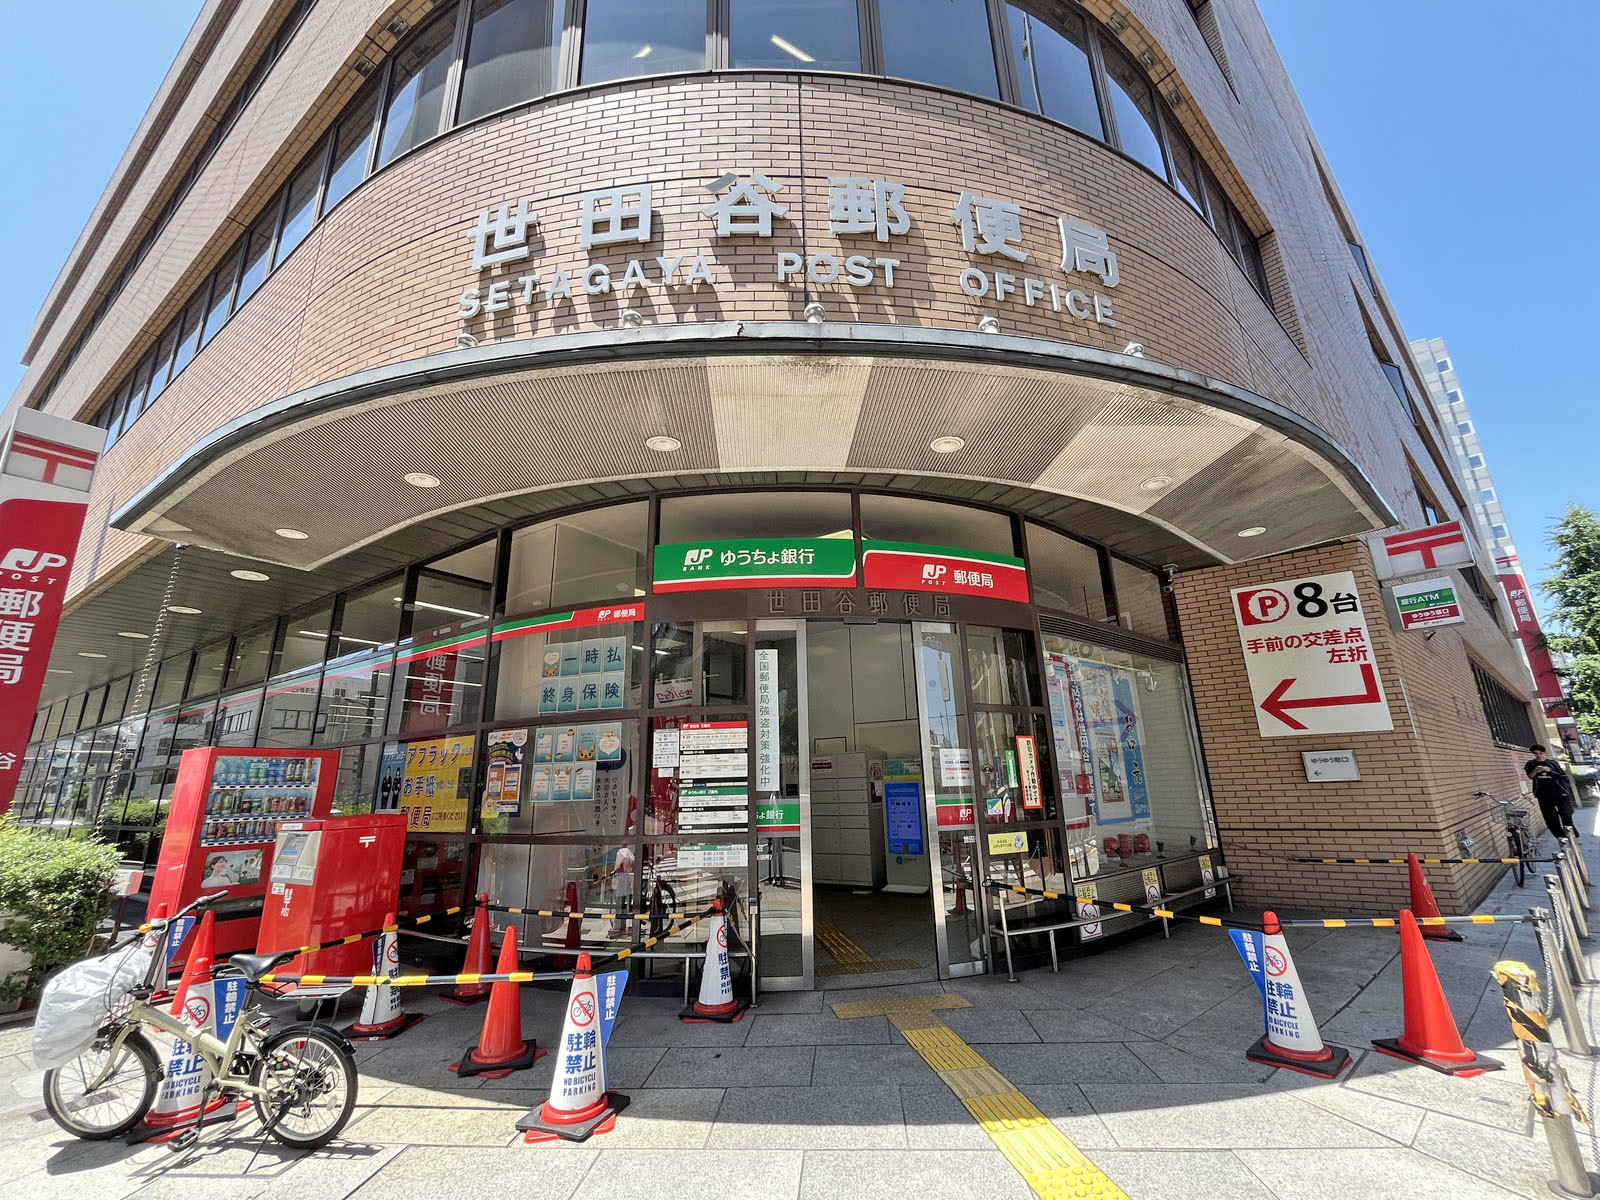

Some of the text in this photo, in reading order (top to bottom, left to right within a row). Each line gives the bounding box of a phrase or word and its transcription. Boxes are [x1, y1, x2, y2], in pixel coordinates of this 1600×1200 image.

[466, 171, 1121, 288] 世田谷郵便局
[458, 251, 1116, 327] SETAGAYA POST OFFICE
[720, 548, 816, 567] ゆうちょ銀行
[0, 570, 56, 585] OST
[953, 569, 995, 588] 郵便局
[767, 589, 951, 618] 世田谷郵便局
[1400, 592, 1440, 606] 銀行ATM
[0, 587, 44, 685] 郵便局
[1246, 627, 1365, 655] 手前の交差点
[1326, 645, 1369, 664] 左折
[542, 681, 620, 704] 終身保険
[756, 809, 785, 820] ょ銀行
[222, 980, 239, 1025] 駐輪禁止
[605, 975, 617, 1021] 駐輪禁止
[1267, 997, 1297, 1019] 禁止
[1274, 1017, 1299, 1030] BICYCLE
[567, 1030, 596, 1053] 駐輪
[167, 1053, 204, 1078] 禁止
[565, 1051, 596, 1075] 禁止
[170, 1075, 202, 1089] BICYCLE
[563, 1072, 596, 1086] NO BICYCLE
[563, 1082, 596, 1097] PARKING
